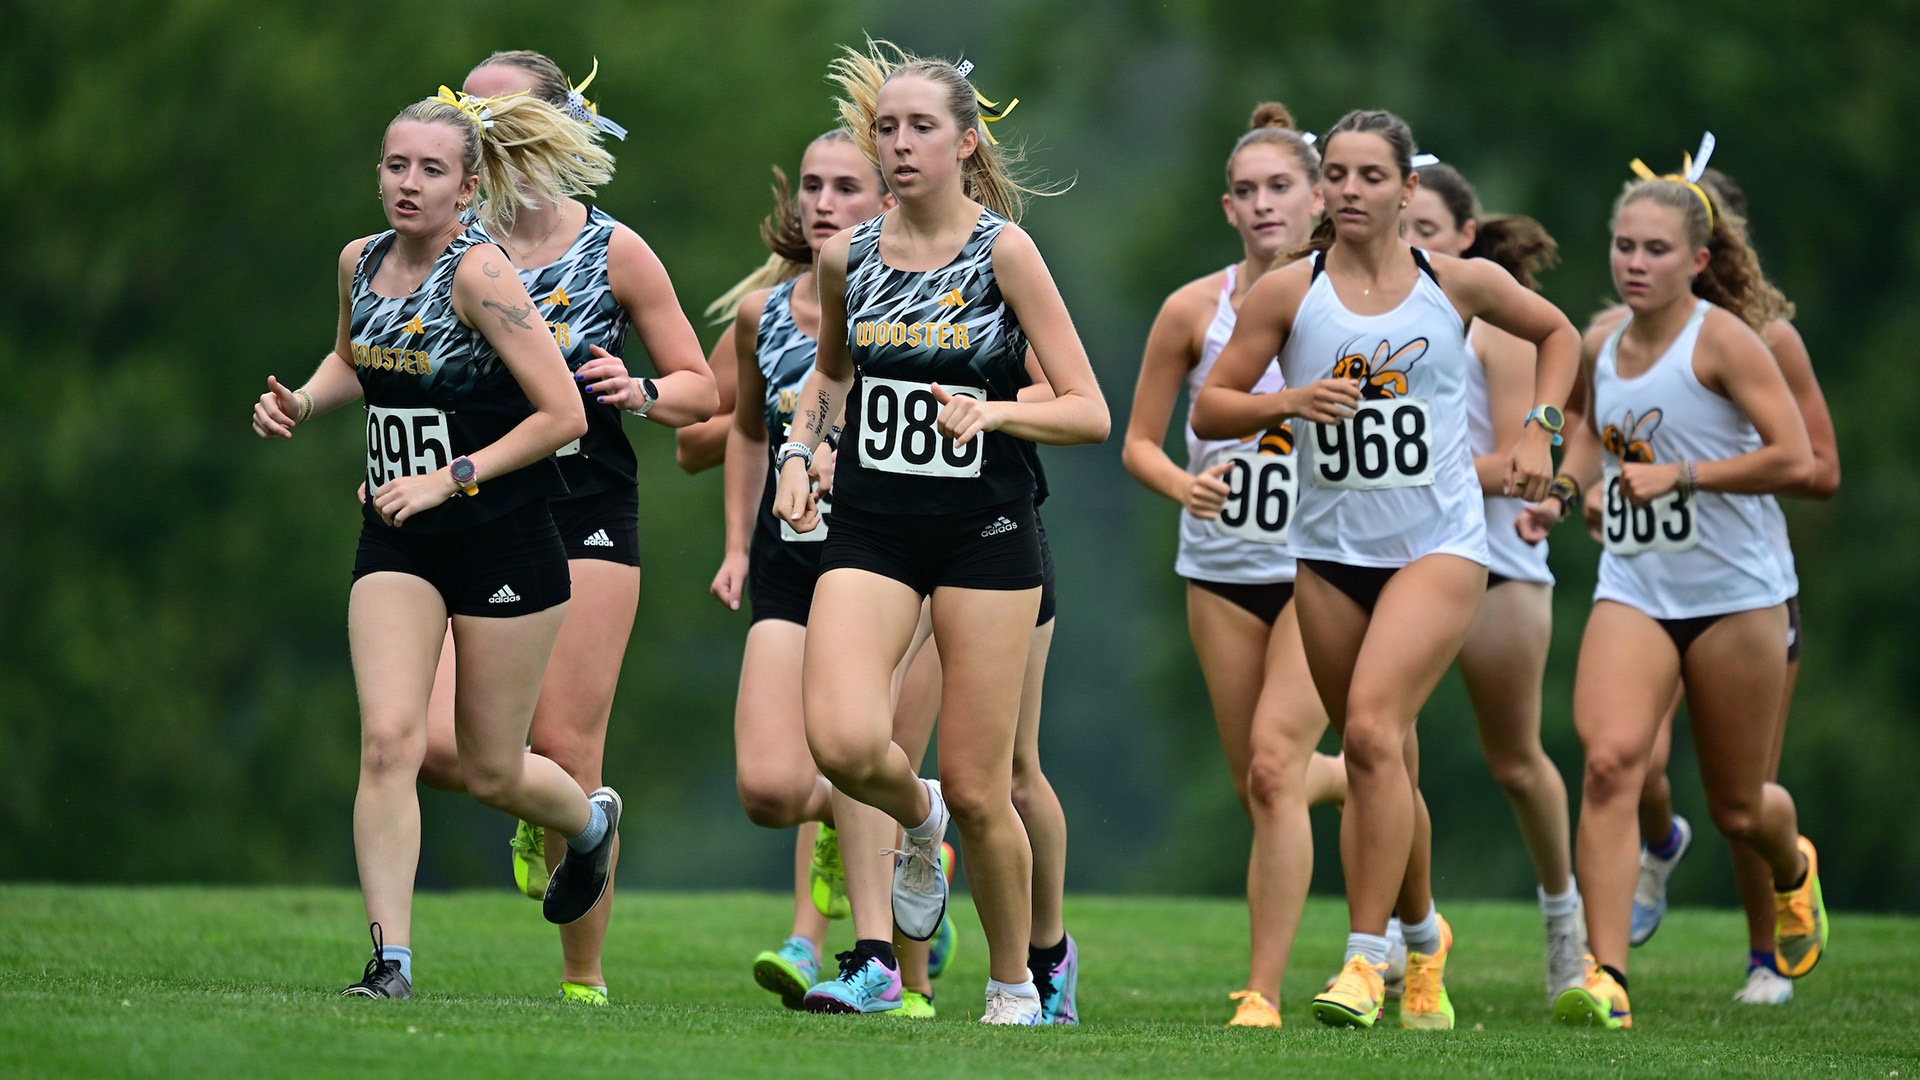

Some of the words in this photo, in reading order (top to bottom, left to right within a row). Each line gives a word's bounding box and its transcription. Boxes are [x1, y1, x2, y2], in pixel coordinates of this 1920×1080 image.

[856, 321, 970, 350] WOOSTER
[369, 412, 448, 487] 995
[1316, 405, 1428, 482] 968
[1221, 458, 1300, 533] 96
[583, 539, 614, 548] adidas
[981, 522, 1018, 537] adidas
[488, 594, 521, 604] adidas
